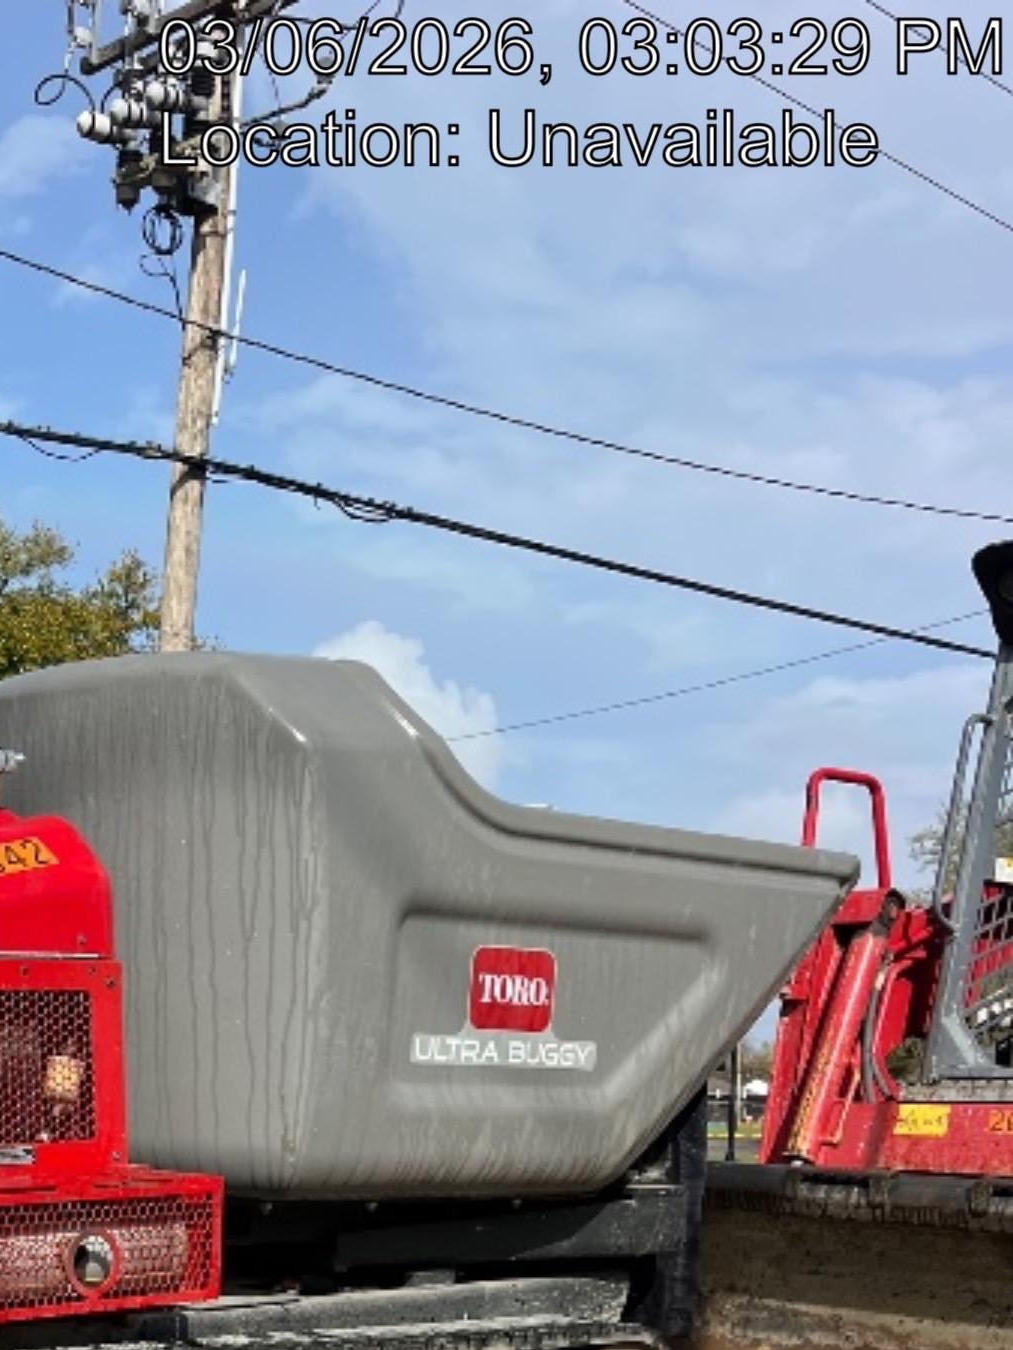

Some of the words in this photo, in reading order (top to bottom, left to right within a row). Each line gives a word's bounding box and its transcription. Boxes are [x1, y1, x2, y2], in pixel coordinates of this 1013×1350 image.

[478, 973, 549, 1006] TORO
[415, 1036, 498, 1064] ULTRA
[508, 1040, 591, 1067] BUGGY
